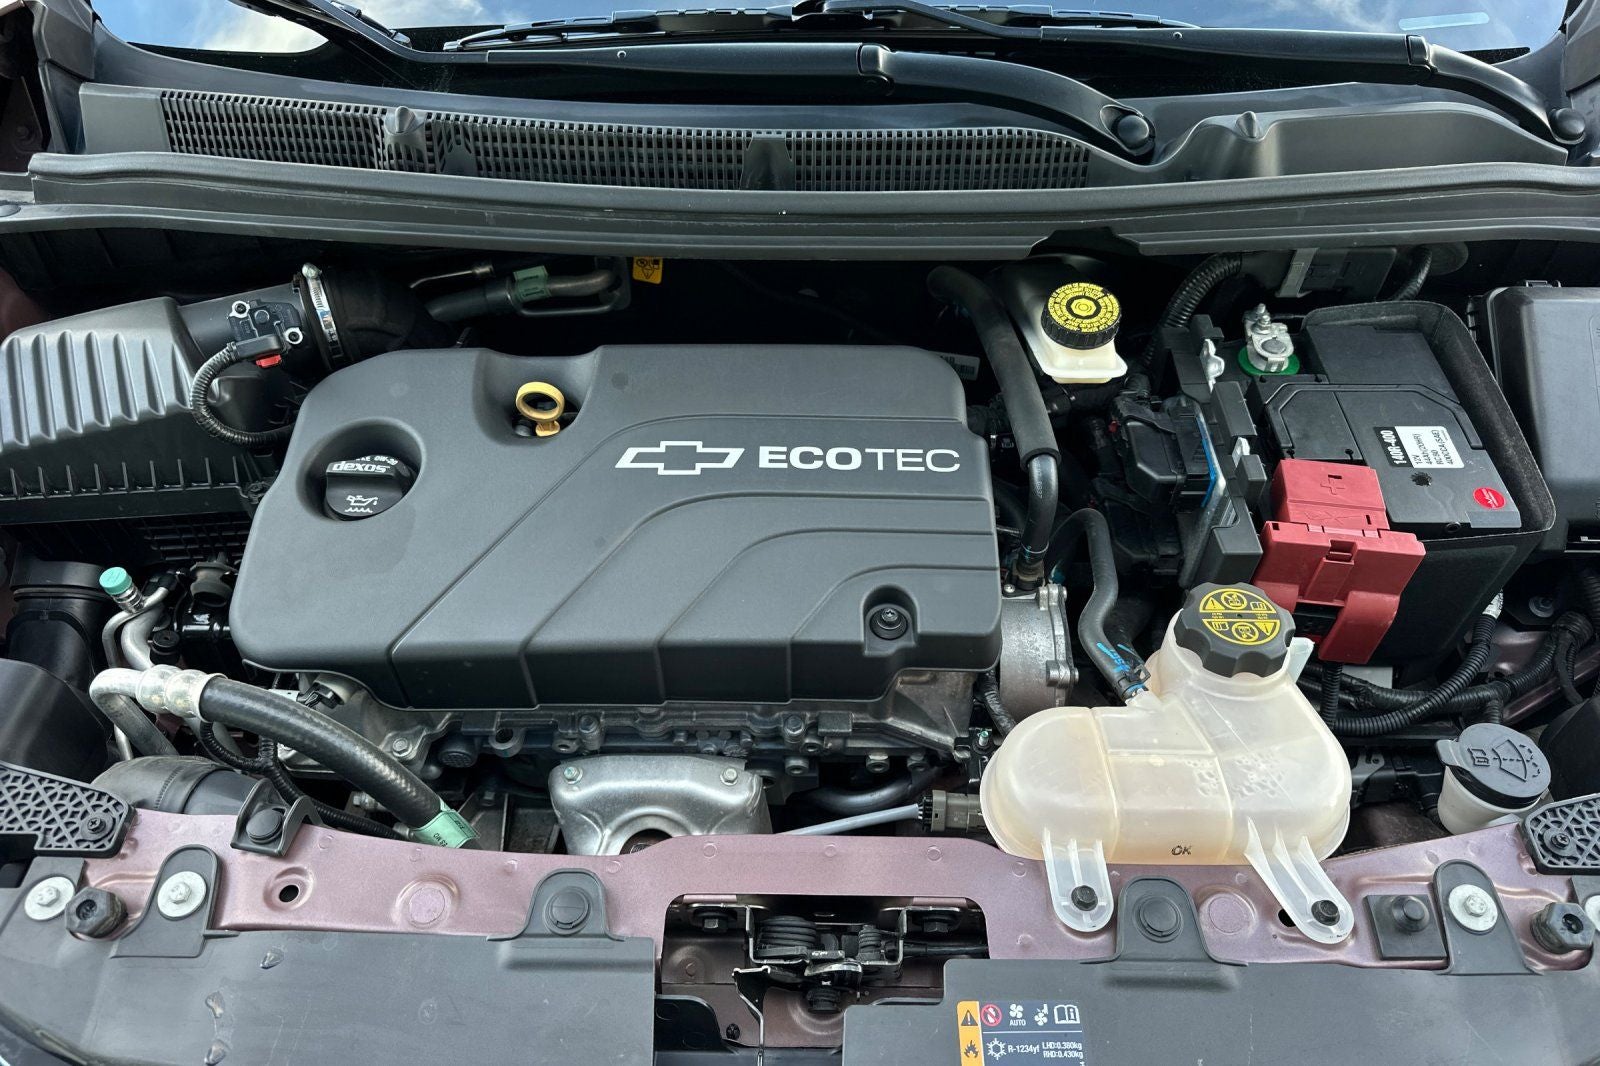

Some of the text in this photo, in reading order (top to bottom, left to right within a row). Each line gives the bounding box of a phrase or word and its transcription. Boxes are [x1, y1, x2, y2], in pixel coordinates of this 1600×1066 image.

[1380, 429, 1407, 465] 140R-400
[332, 460, 390, 473] dexos
[758, 445, 961, 473] ECOTEC
[1170, 844, 1192, 856] OK
